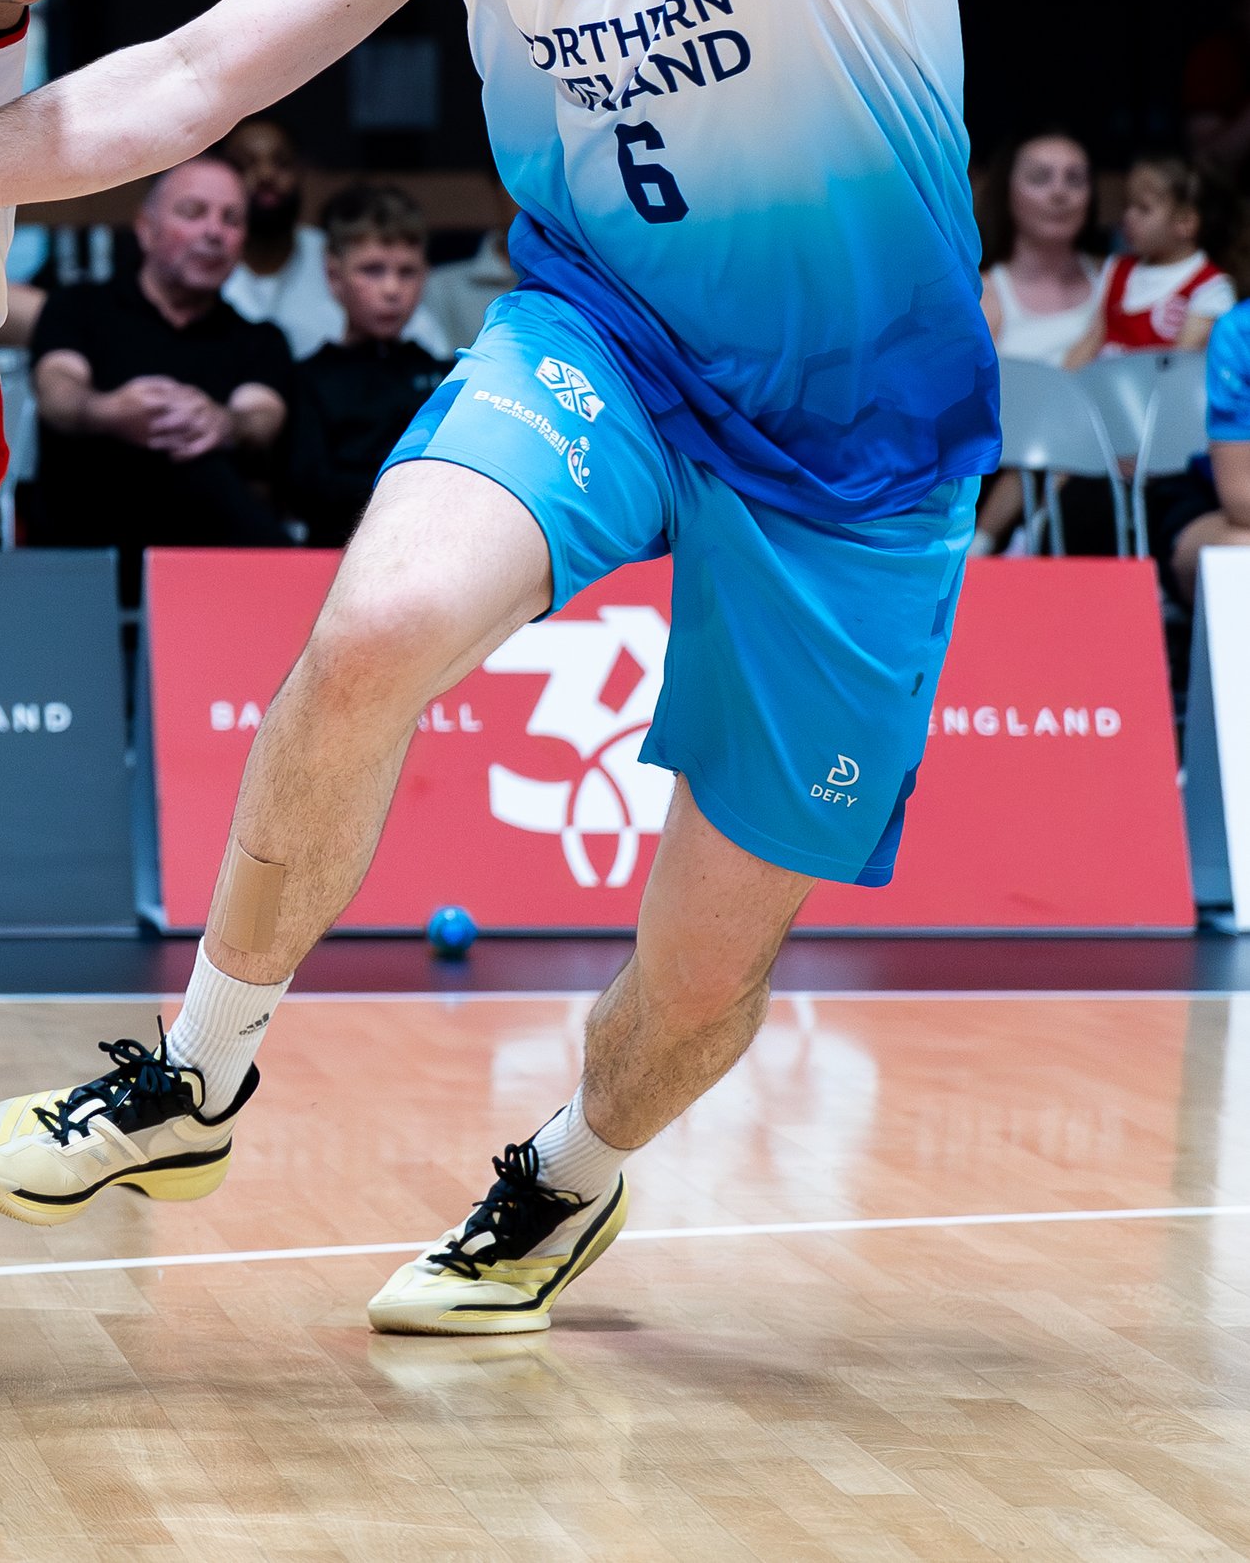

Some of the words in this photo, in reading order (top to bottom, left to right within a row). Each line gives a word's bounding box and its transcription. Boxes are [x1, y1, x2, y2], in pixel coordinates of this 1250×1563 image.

[614, 120, 689, 224] 6
[473, 390, 570, 452] Basketball
[493, 403, 538, 429] Northern
[810, 784, 858, 808] DEFY
